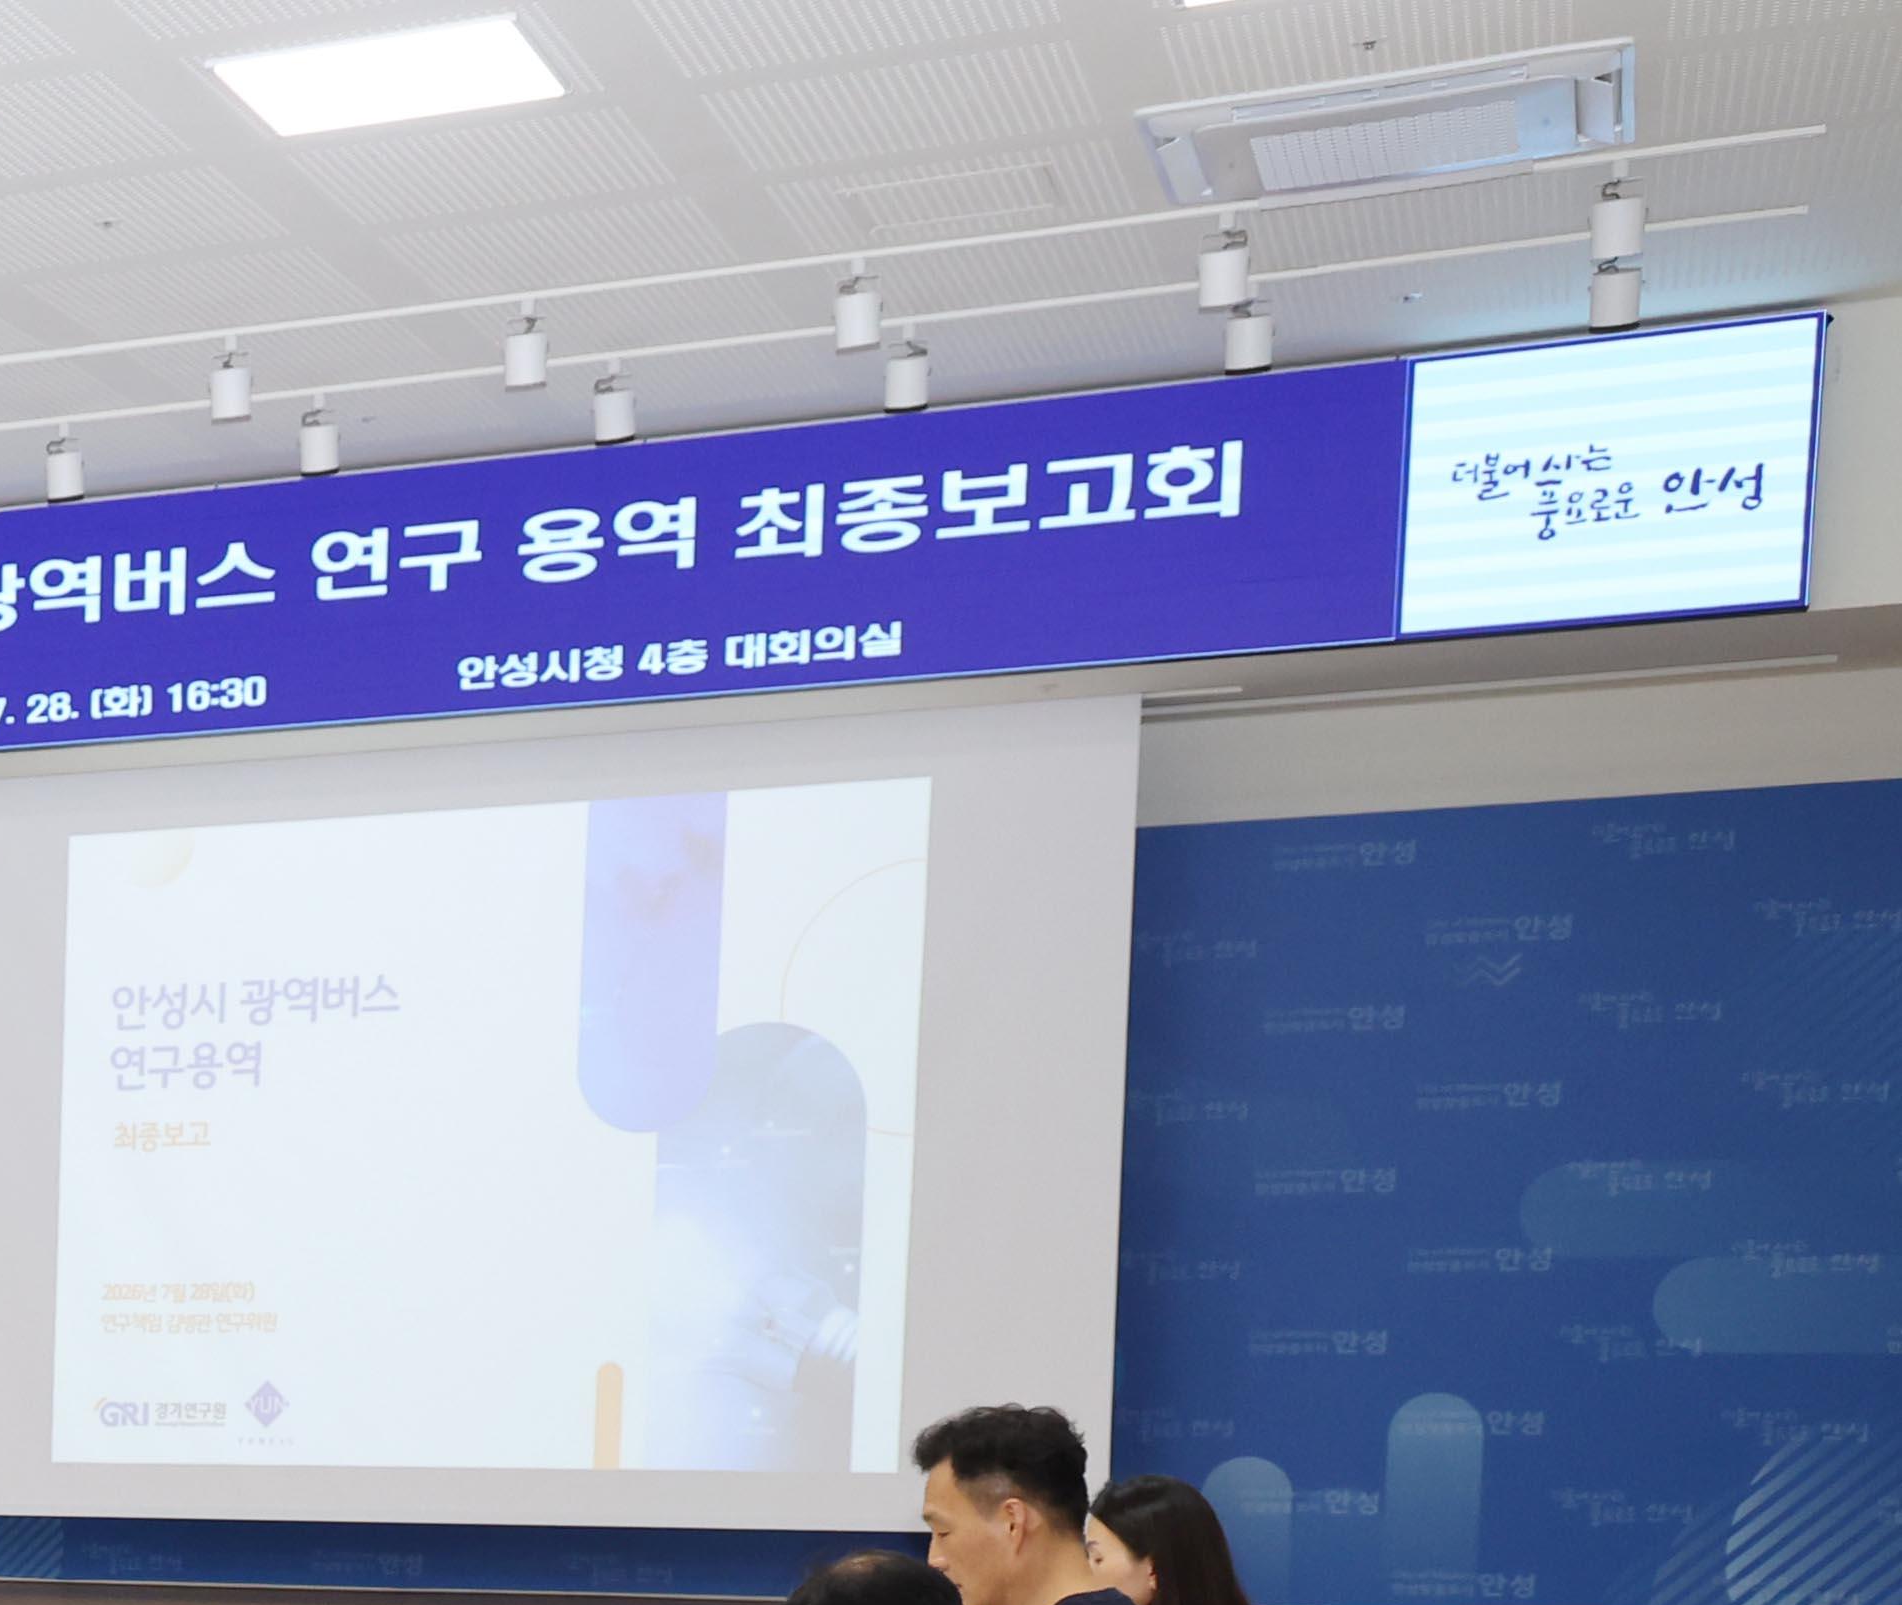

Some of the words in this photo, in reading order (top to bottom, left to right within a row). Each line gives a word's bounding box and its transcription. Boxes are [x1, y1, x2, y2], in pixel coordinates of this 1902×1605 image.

[1451, 453, 1531, 500] 더불어
[1541, 444, 1612, 472] 사는
[1663, 462, 1764, 513] 안성
[311, 519, 482, 601] 연구
[518, 496, 697, 583] 용역
[735, 440, 1243, 558] 최종보고회
[1530, 479, 1640, 540] 풍요로운
[457, 645, 624, 691] 안성시청
[637, 639, 709, 675] 4층
[725, 621, 902, 669] 대회의실
[26, 691, 80, 724] 28.
[167, 675, 267, 713] 16:30
[111, 982, 227, 1031] 안성시
[239, 973, 401, 1026] 광역버스
[109, 1040, 263, 1091] 연구용역
[113, 1119, 211, 1152] 최종보고
[98, 1401, 150, 1428] GRI
[154, 1401, 228, 1420] 경기연구원
